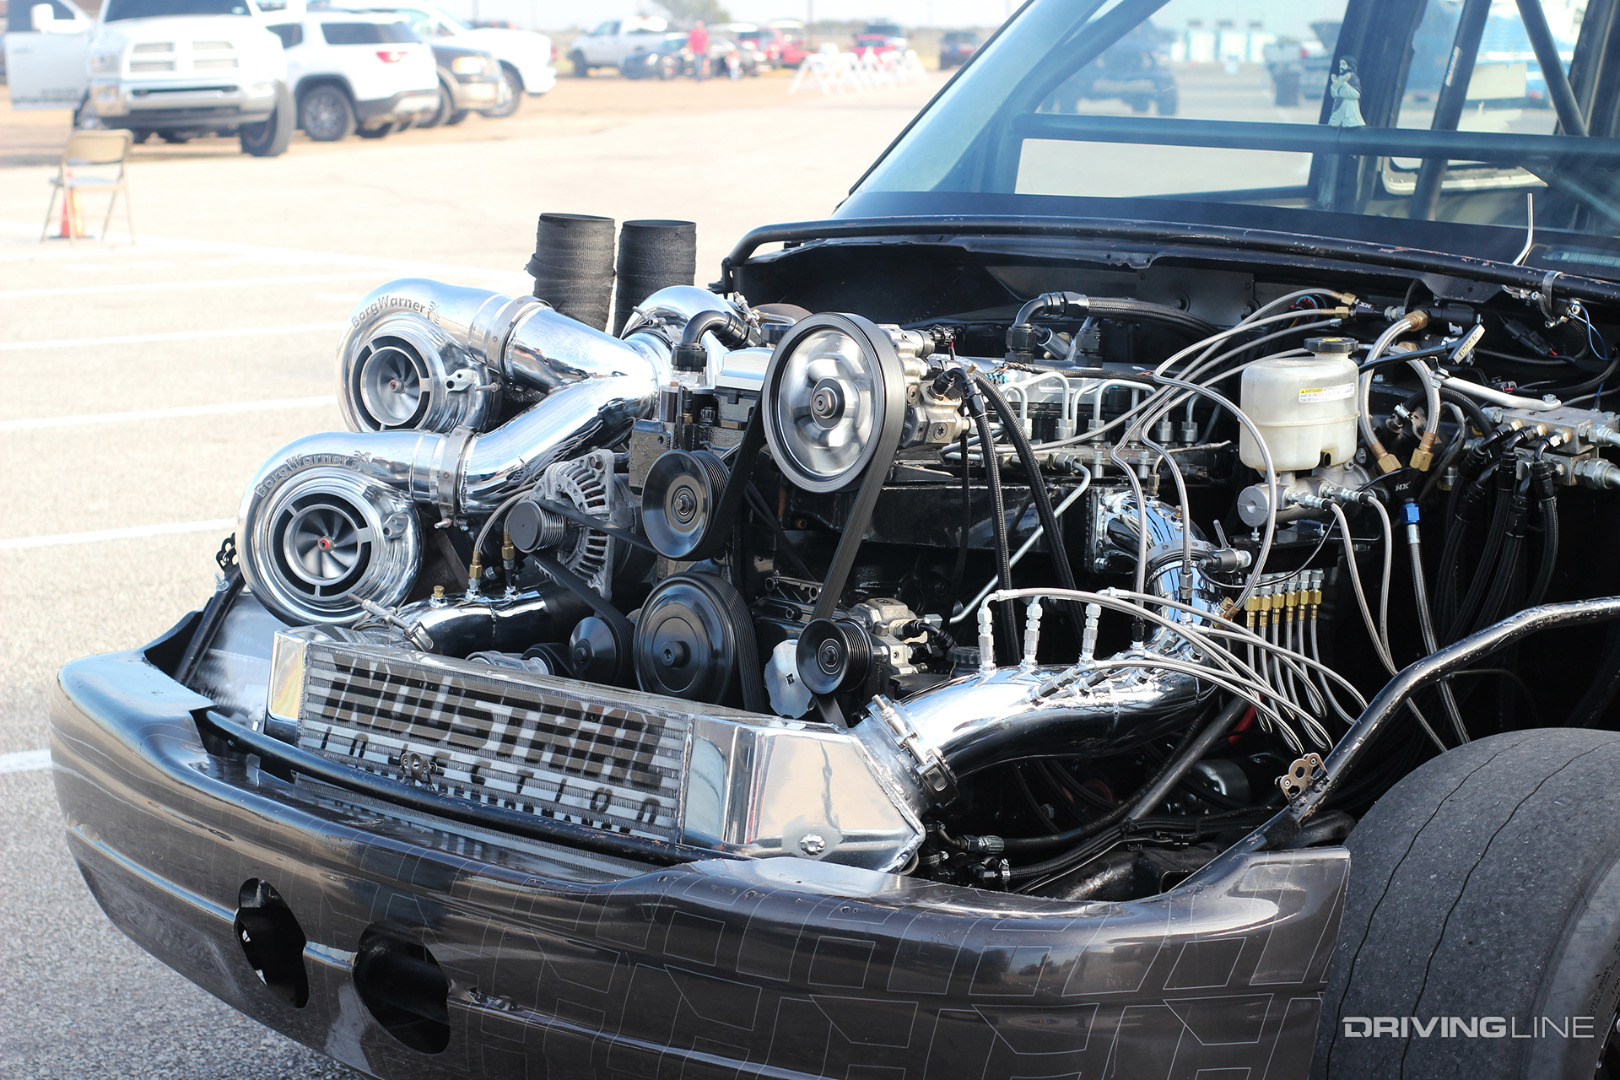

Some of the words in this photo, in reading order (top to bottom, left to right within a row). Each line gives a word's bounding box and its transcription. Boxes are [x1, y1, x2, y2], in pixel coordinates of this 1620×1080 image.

[351, 295, 426, 329] BorgWarner
[254, 453, 350, 498] BorgWarner
[321, 652, 667, 790] INDUSTRIAL
